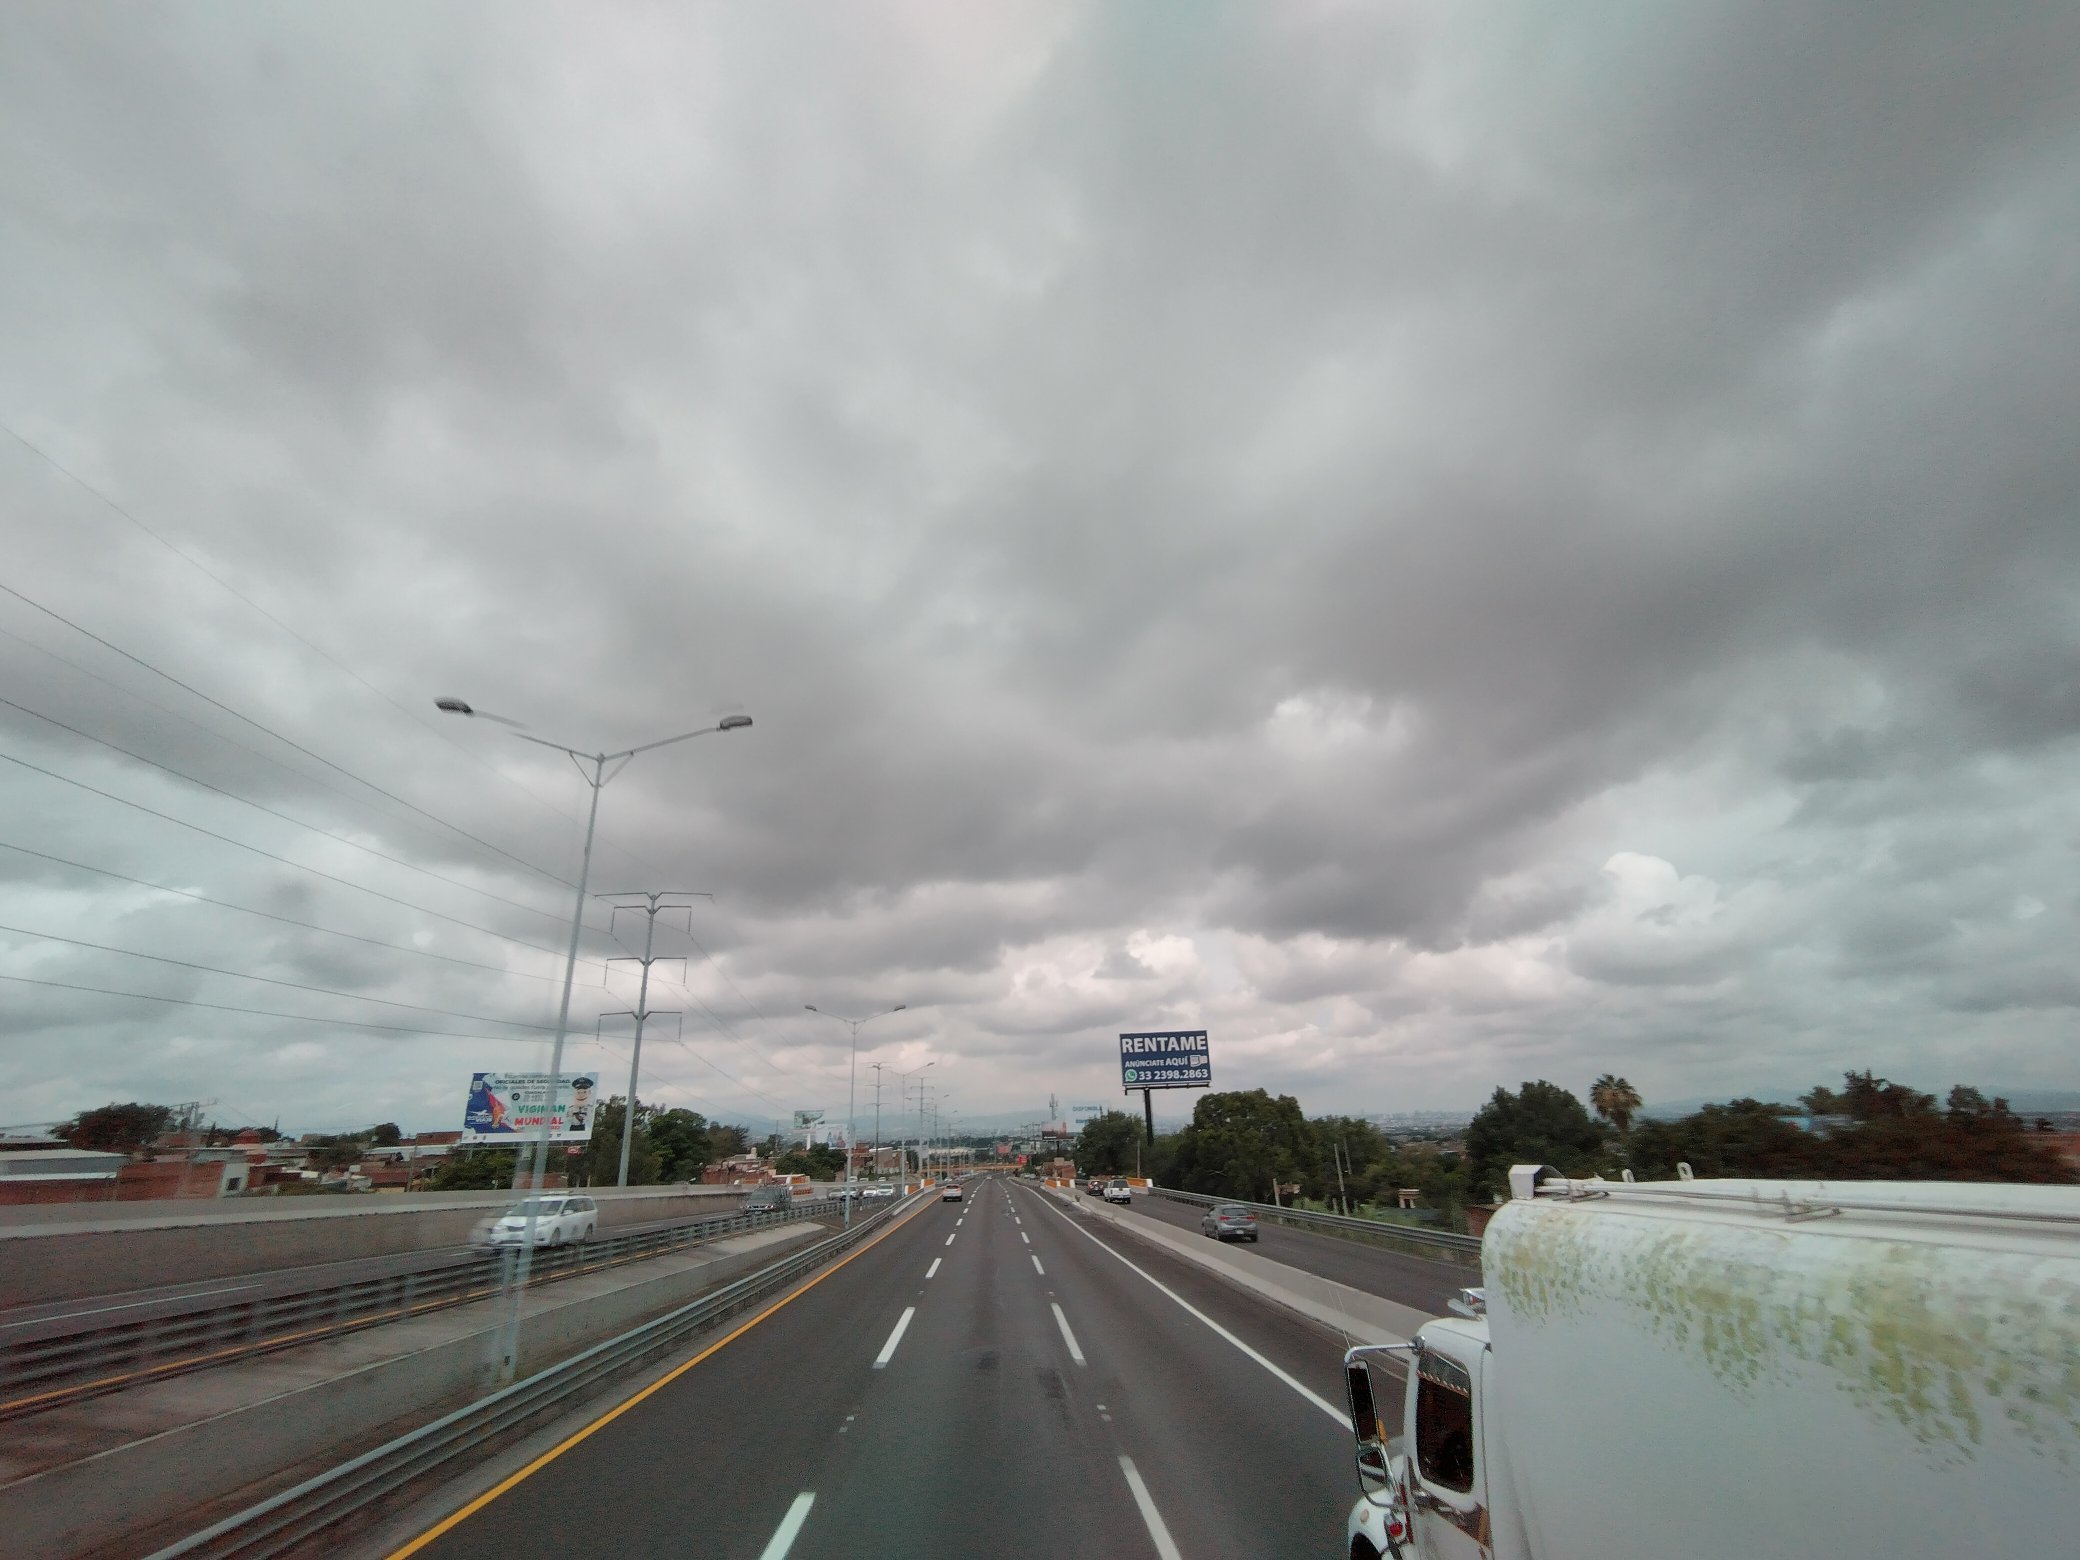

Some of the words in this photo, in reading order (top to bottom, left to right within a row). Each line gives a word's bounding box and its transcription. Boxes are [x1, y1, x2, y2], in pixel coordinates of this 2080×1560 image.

[1121, 1035, 1207, 1053] RENTAME
[1125, 1059, 1165, 1068] ANÚNCIATE
[1165, 1056, 1188, 1066] AQUÍ
[1138, 1071, 1152, 1081] 33
[1154, 1069, 1209, 1081] 2398.2863
[514, 1116, 564, 1126] MUNDAL
